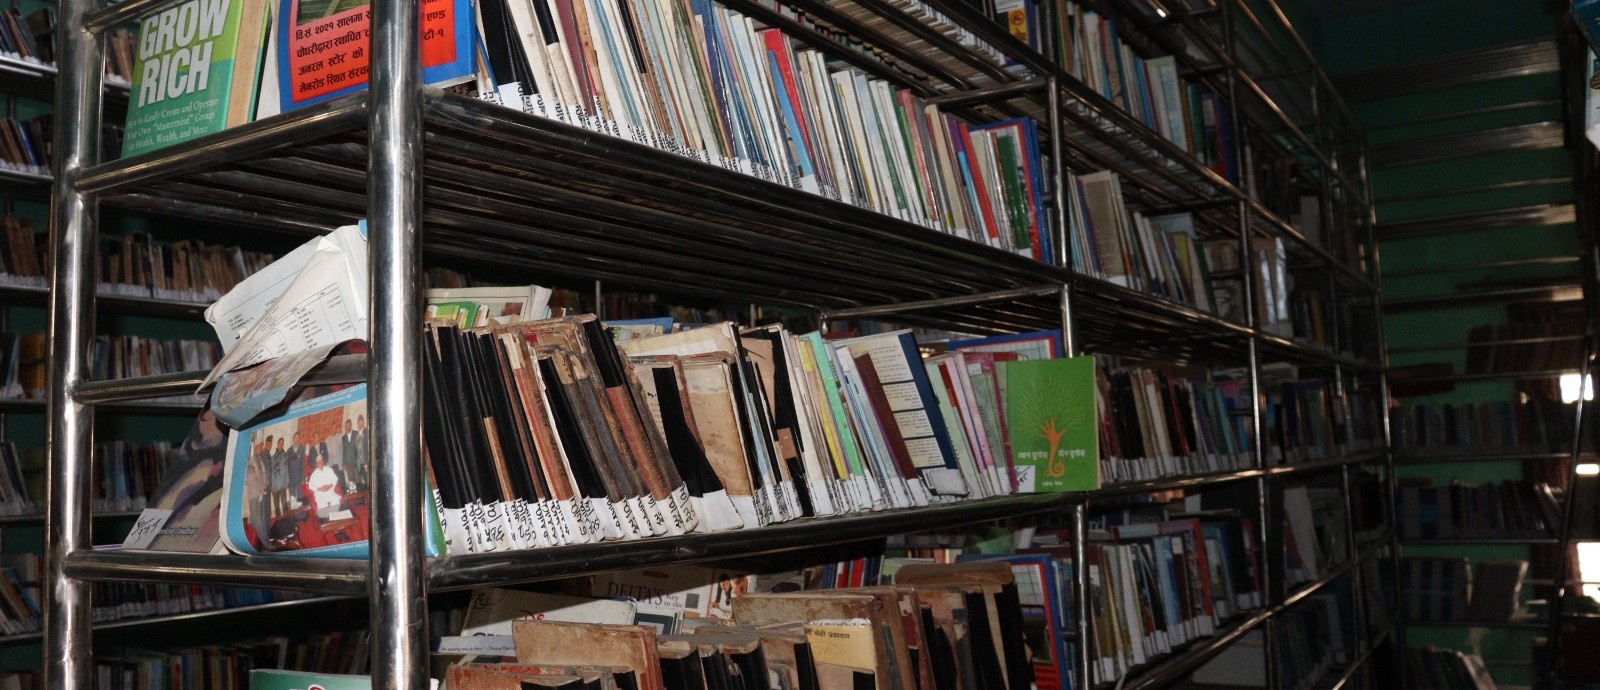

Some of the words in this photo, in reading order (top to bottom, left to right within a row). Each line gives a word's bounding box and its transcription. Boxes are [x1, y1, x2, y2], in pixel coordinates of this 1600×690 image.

[140, 0, 230, 61] GROW
[336, 12, 363, 28] सालमा
[334, 31, 361, 46] स्थापित
[298, 60, 323, 75] जनरल
[352, 47, 363, 58] को
[138, 40, 213, 109] RICH
[327, 73, 346, 85] स्थित
[144, 111, 160, 123] Easily
[161, 108, 181, 117] Create
[181, 102, 193, 113] and
[193, 98, 220, 111] Operate
[194, 111, 215, 123] Group
[156, 131, 179, 143] Wealth,
[179, 127, 191, 138] and
[191, 125, 208, 136] More
[608, 581, 664, 605] DELTA'S
